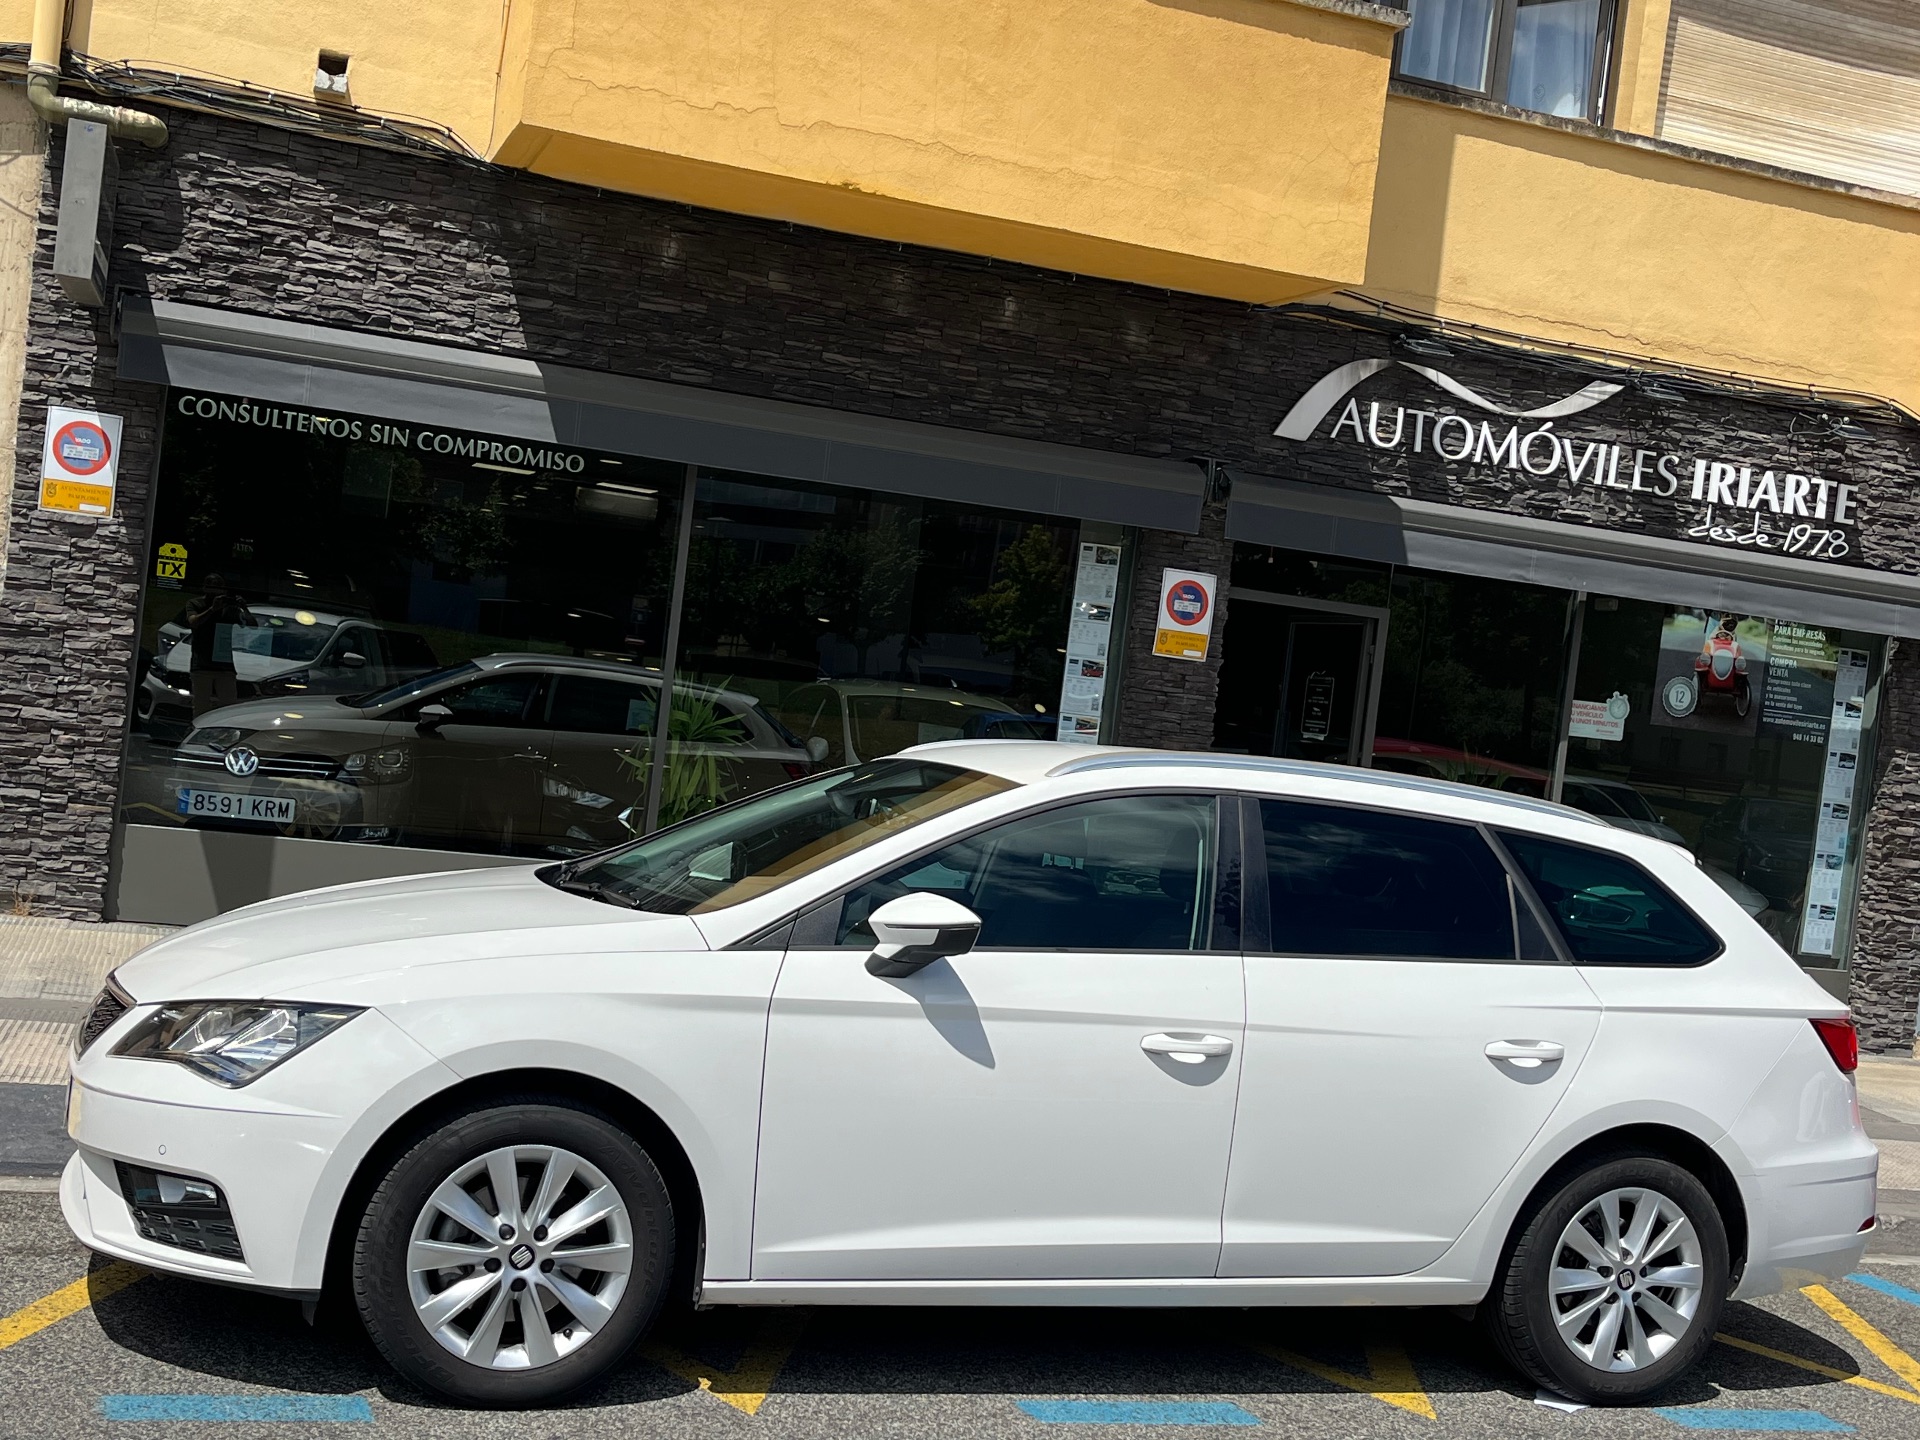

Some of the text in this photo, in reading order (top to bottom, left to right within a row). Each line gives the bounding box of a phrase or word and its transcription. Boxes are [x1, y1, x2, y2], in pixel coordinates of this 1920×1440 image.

[178, 395, 585, 473] CONSULTENOS SIN COMPROMISO
[1331, 397, 1859, 526] AUTOMÓVILES IRIARTE
[1688, 507, 1849, 558] desde 1978
[158, 560, 184, 578] TX
[1774, 624, 1826, 641] PARA EMPRESAS
[1770, 656, 1797, 669] COMPRA
[1769, 666, 1788, 678] VENTA
[1675, 690, 1686, 704] 12
[193, 794, 243, 814] 8591
[251, 799, 290, 819] KRM
